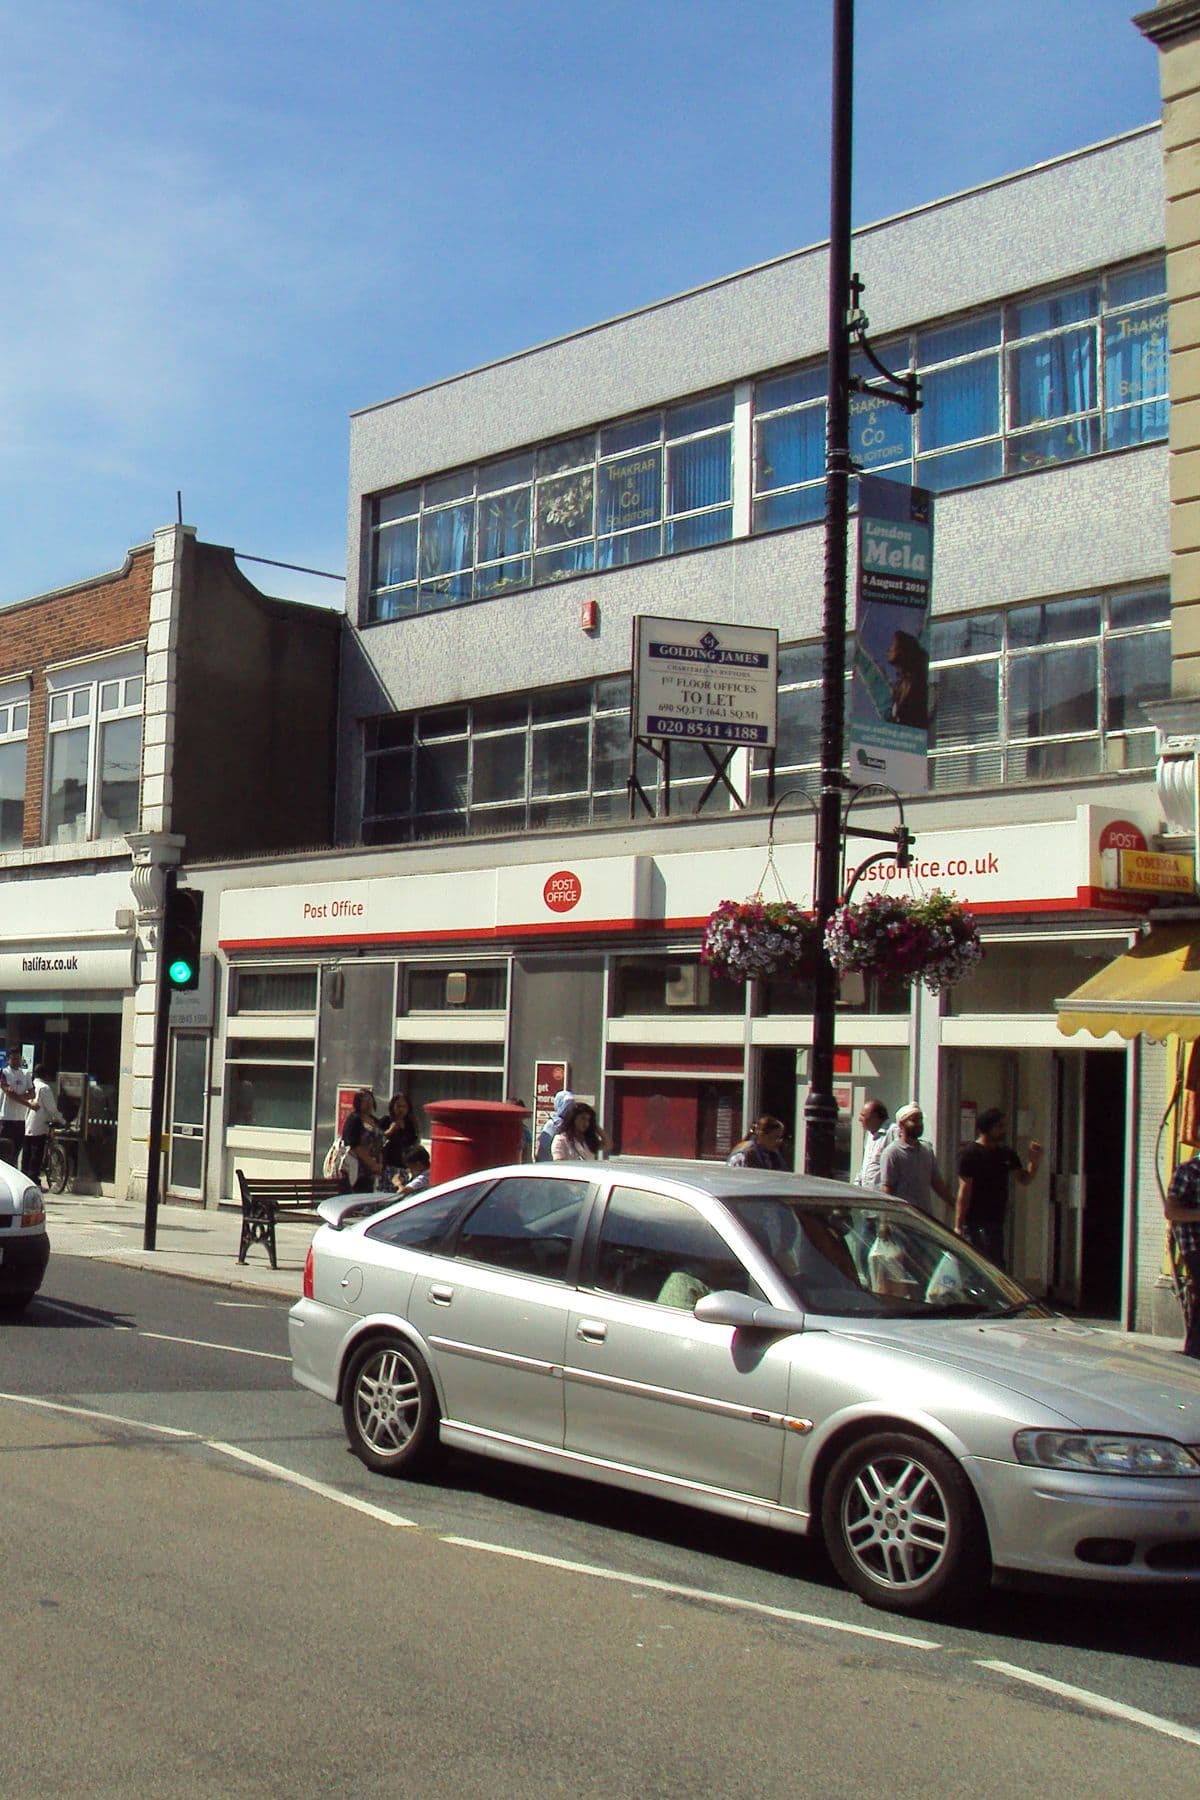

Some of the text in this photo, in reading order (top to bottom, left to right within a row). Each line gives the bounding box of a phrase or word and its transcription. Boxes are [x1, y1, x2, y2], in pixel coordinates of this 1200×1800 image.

[868, 412, 877, 425] &
[849, 443, 904, 465] OLICITORS
[607, 458, 656, 480] THAKRAR
[865, 521, 913, 542] London
[865, 538, 927, 572] Mela
[868, 576, 903, 590] August
[905, 582, 926, 593] 2010
[659, 645, 760, 664] GOLDING JAMES
[676, 677, 711, 689] FLOOR
[713, 682, 757, 694] OFFICES
[680, 690, 736, 707] TO LET
[658, 703, 674, 712] 690
[657, 719, 758, 740] 020 8541 4188
[1110, 831, 1138, 848] POST
[1135, 856, 1180, 871] OMEGA
[551, 879, 574, 891] POST
[546, 890, 578, 903] OFFICE
[303, 900, 364, 919] Post Office
[22, 955, 78, 972] halifax.co.uk
[537, 1083, 549, 1094] get
